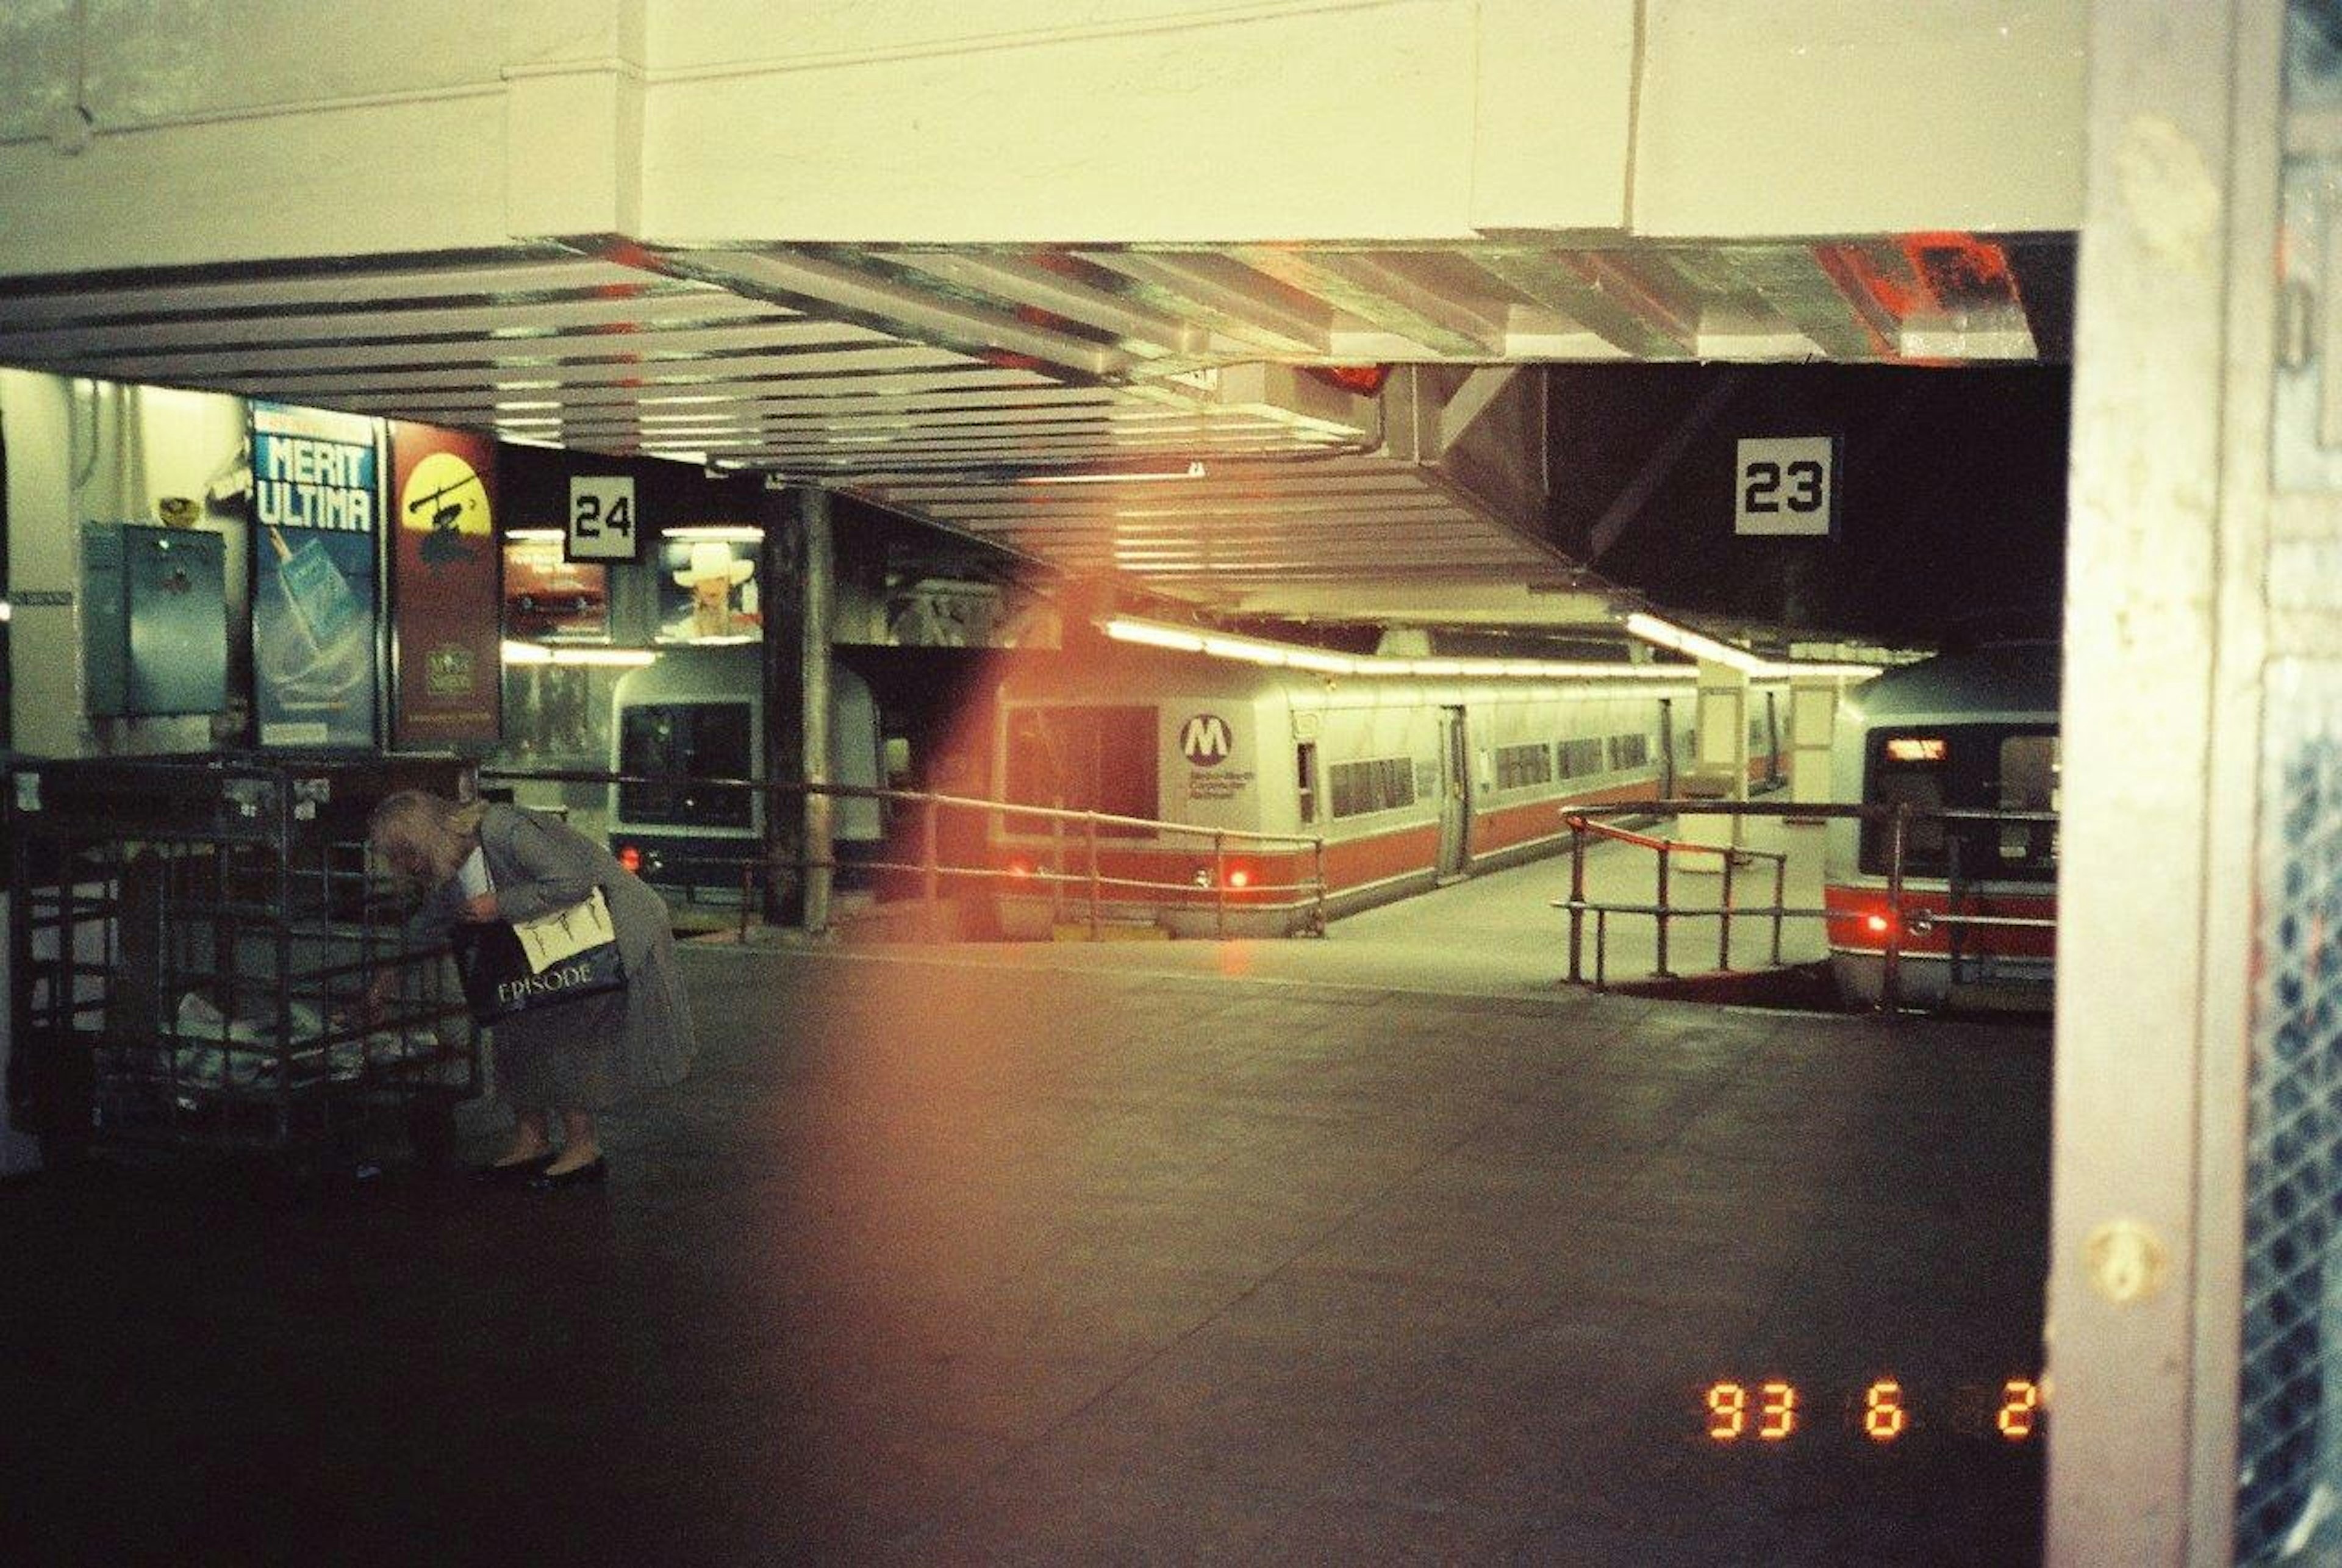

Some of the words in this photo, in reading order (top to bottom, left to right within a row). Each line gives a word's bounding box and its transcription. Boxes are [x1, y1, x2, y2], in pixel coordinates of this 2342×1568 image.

[268, 435, 364, 488] MERIT
[257, 479, 371, 532] ULTIMA
[1746, 462, 1822, 512] 23
[577, 496, 631, 537] 24
[1184, 718, 1228, 756] M
[498, 963, 593, 1003] EPISODE
